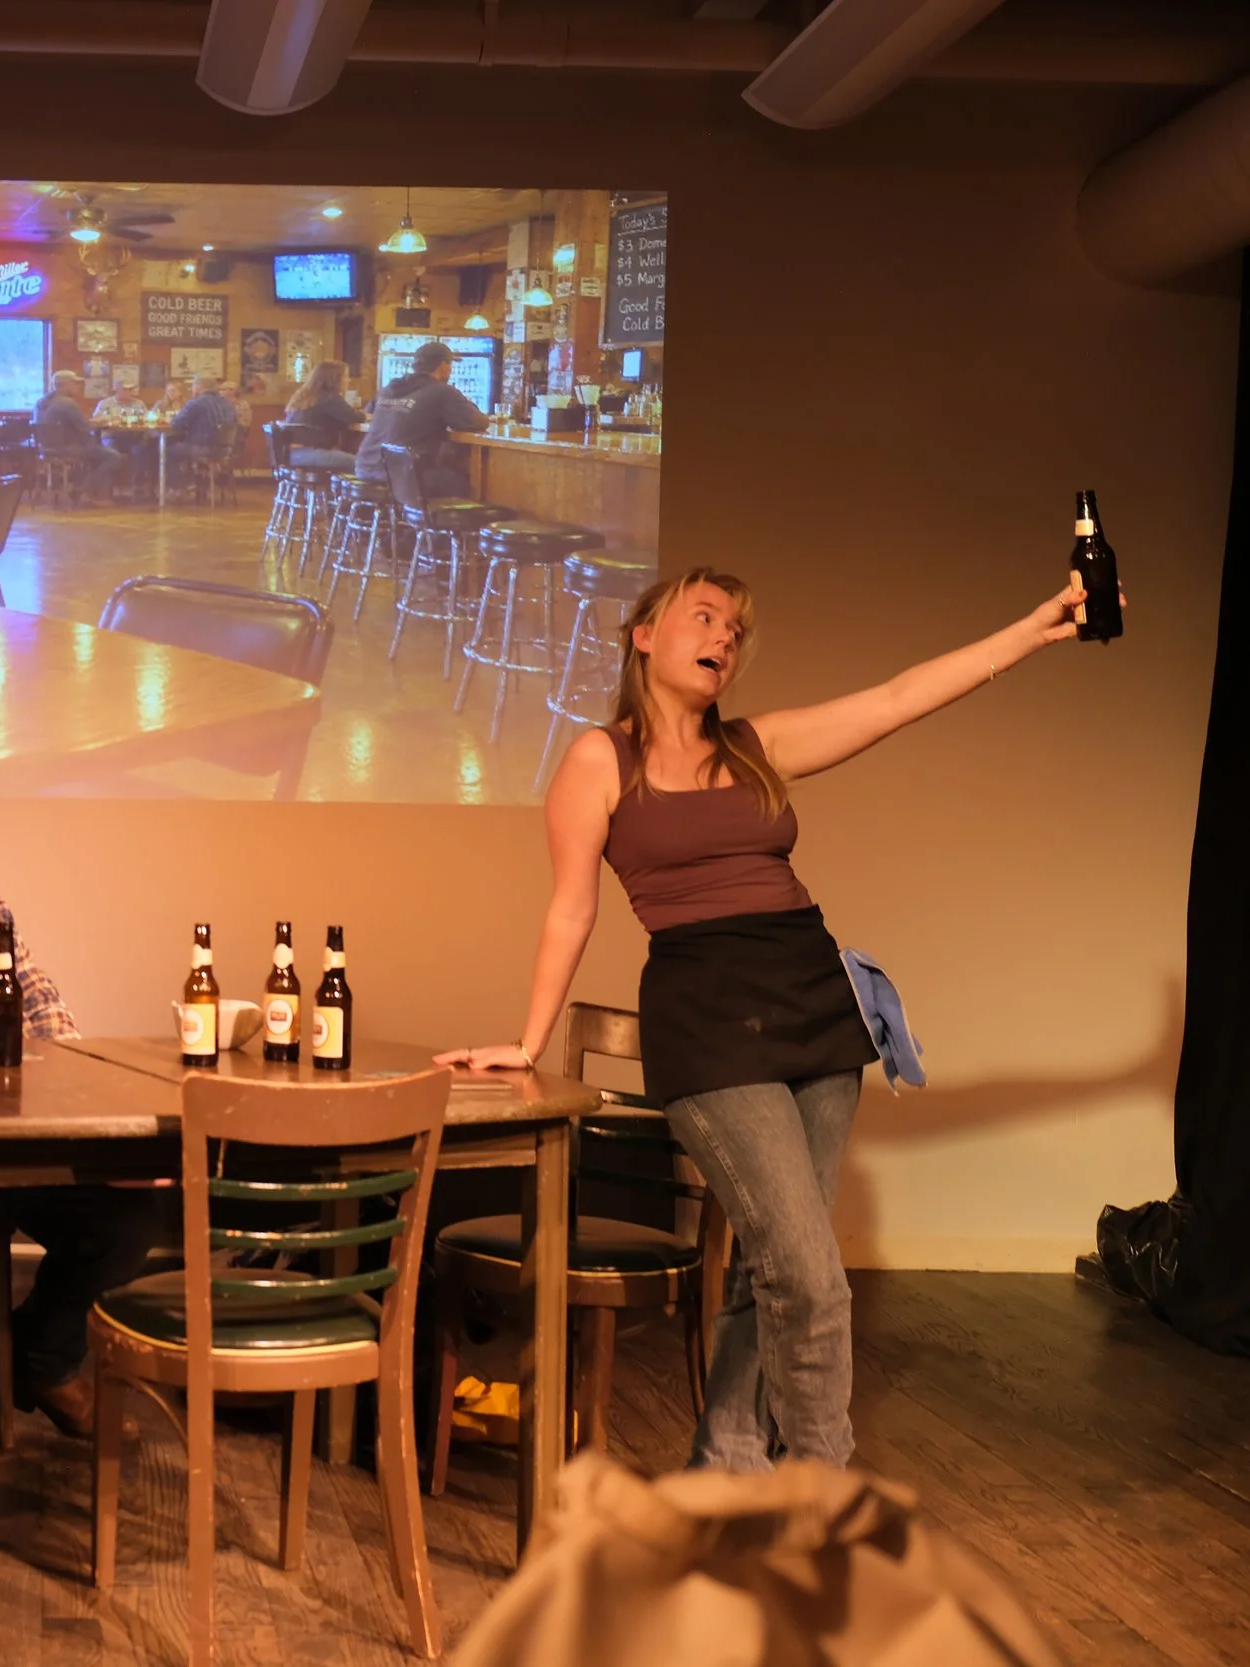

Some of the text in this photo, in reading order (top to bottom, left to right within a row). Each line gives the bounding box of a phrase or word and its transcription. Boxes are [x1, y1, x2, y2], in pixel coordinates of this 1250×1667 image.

[618, 214, 656, 232] Today's
[618, 239, 634, 251] $3
[617, 257, 632, 269] $4
[616, 274, 632, 287] $5
[148, 296, 222, 312] COLD BEER
[619, 298, 649, 314] Good
[148, 311, 223, 325] GOOD FRIENDS
[622, 315, 649, 332] Cold
[148, 326, 223, 339] GREAT TIMES
